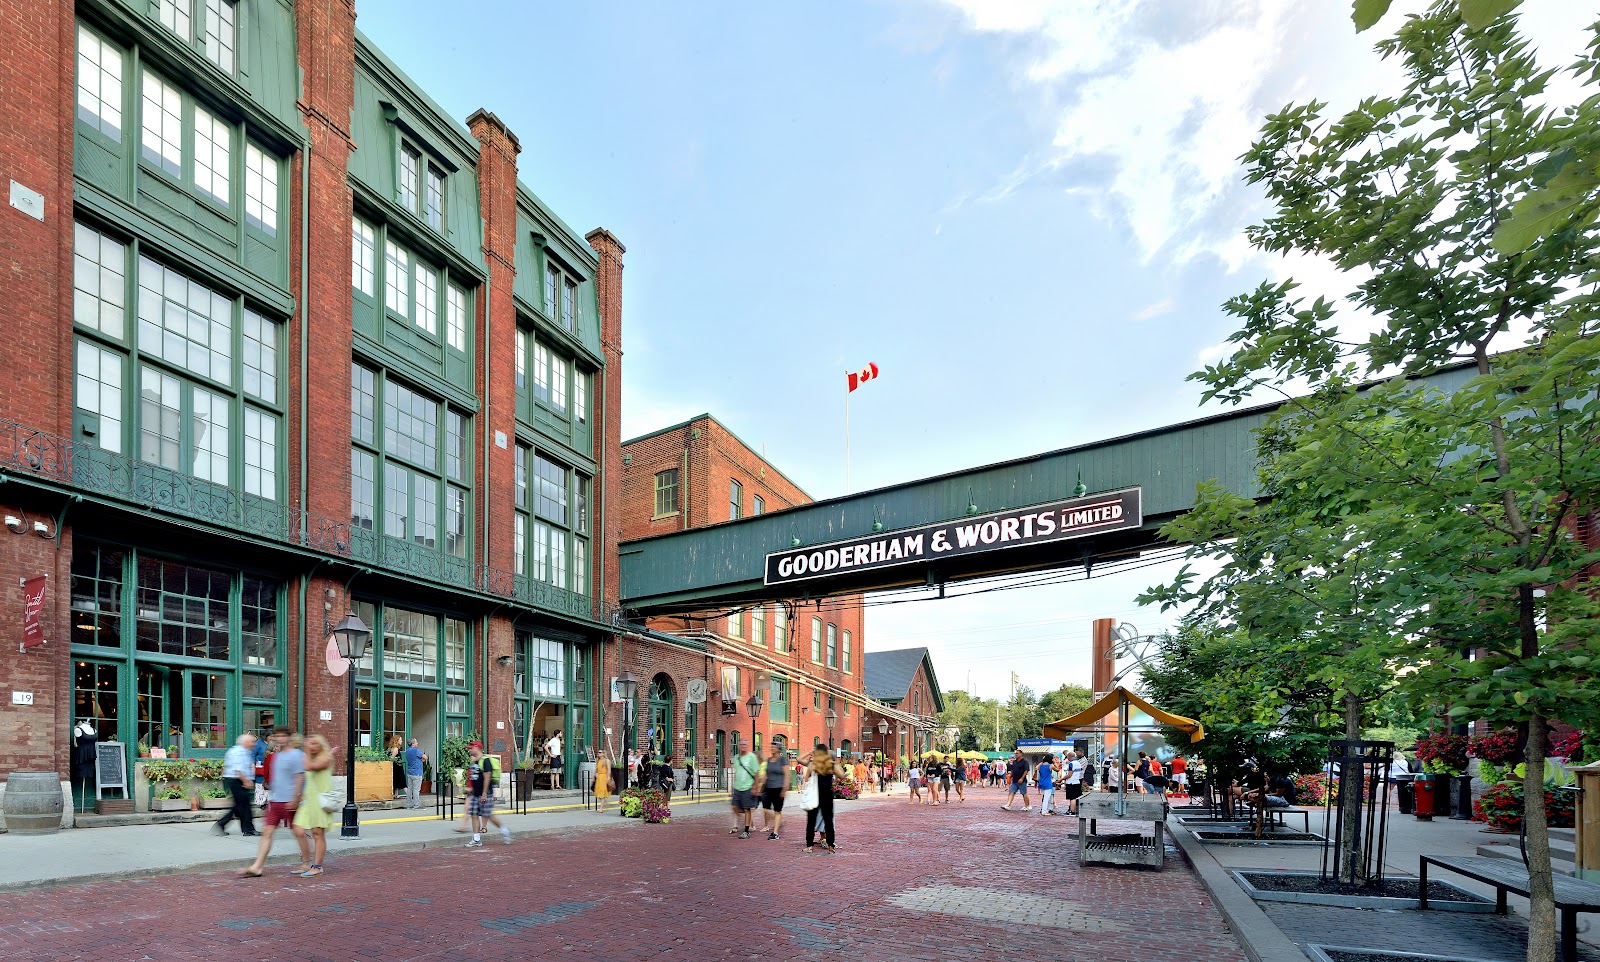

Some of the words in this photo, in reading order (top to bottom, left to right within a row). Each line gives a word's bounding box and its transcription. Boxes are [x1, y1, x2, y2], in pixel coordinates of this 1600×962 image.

[778, 534, 924, 577] GOODERHAM
[931, 529, 953, 552] &
[955, 511, 1056, 549] WORTS
[1061, 505, 1122, 528] LIMITED
